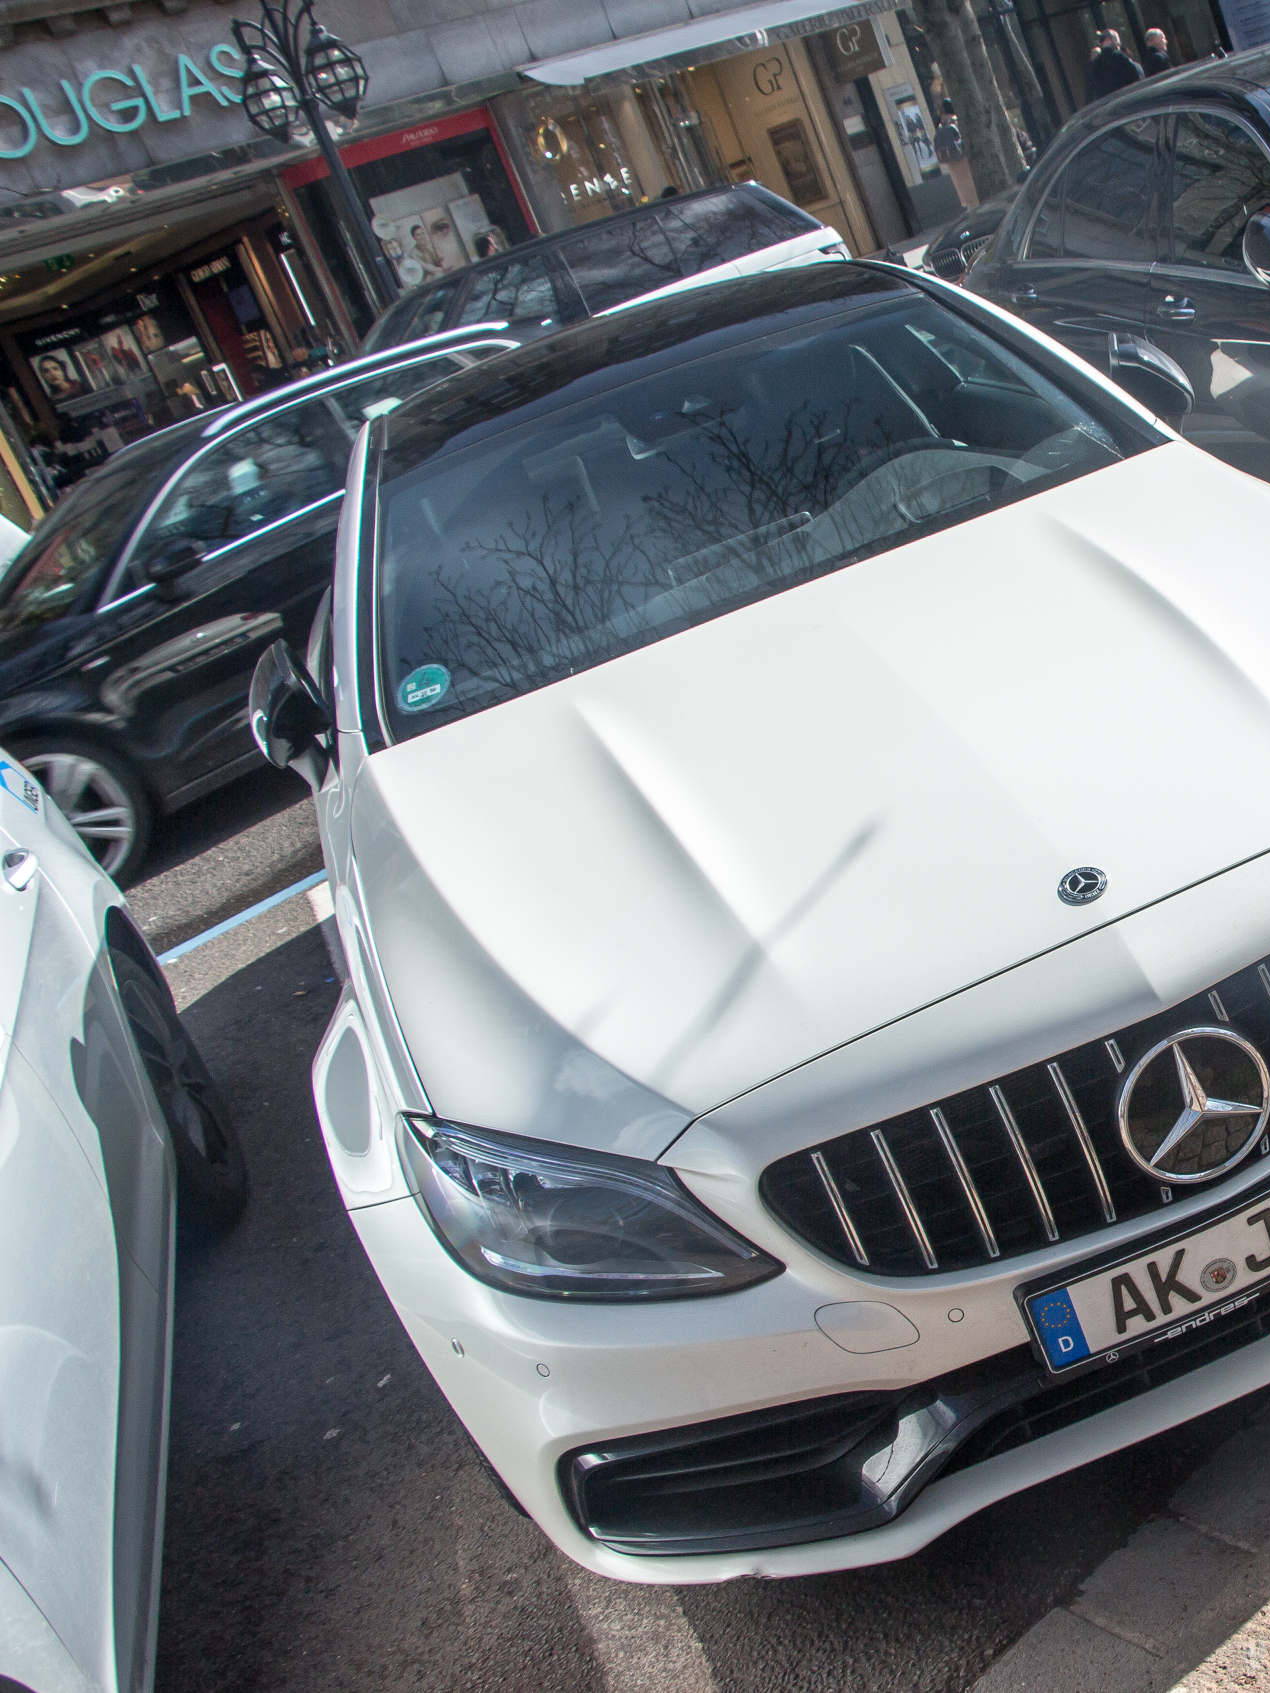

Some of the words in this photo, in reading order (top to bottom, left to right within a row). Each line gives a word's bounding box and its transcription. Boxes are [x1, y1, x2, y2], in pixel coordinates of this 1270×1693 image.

[1111, 1248, 1203, 1334] AK
[1161, 1294, 1255, 1341] endres
[1058, 1335, 1074, 1353] D
